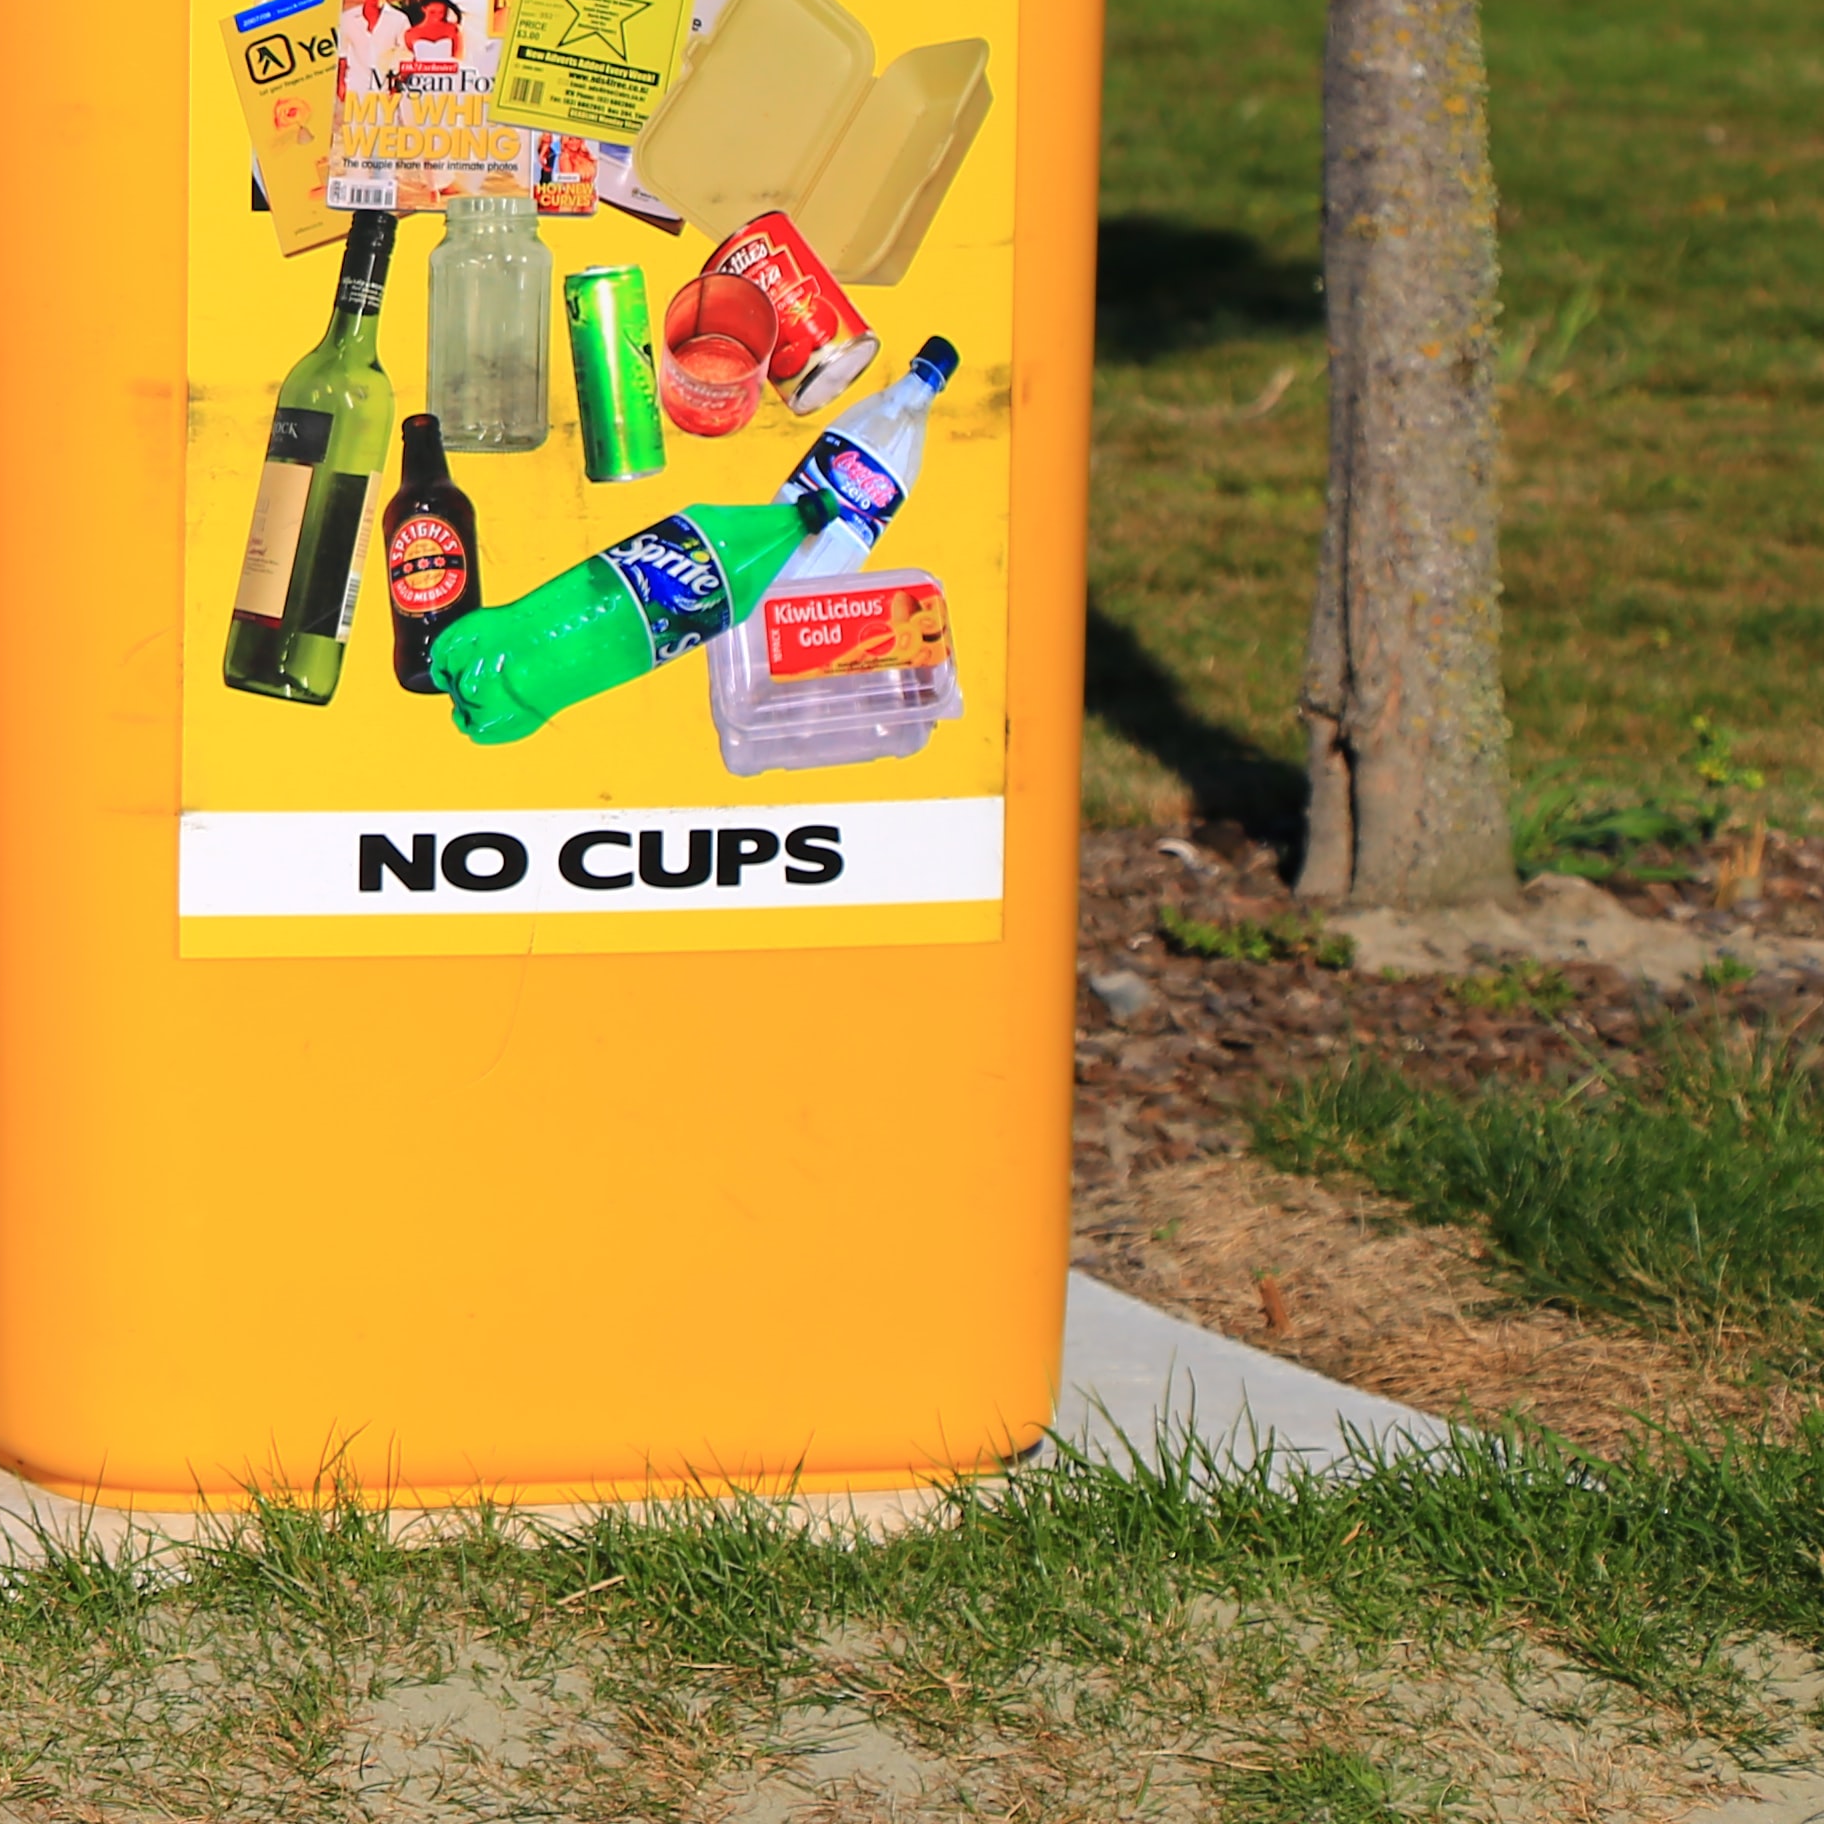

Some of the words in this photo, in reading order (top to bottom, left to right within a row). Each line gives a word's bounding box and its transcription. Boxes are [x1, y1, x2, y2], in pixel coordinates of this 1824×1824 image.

[518, 19, 548, 31] PRICE
[525, 48, 545, 60] New
[545, 51, 579, 68] Adverts
[578, 58, 606, 73] Added
[605, 63, 629, 79] Every
[343, 90, 401, 125] MY
[339, 124, 522, 162] WEDDING
[342, 157, 360, 168] The
[361, 159, 394, 172] couple
[395, 159, 421, 170] share
[423, 159, 444, 170] their
[446, 159, 486, 171] intimate
[486, 160, 519, 173] photos
[537, 182, 563, 195] HOT
[564, 182, 594, 196] NEW
[539, 194, 592, 207] CURVES
[841, 480, 871, 511] zero
[612, 532, 721, 597] Sprite
[773, 596, 884, 624] KiwiLicious
[798, 622, 843, 649] Gold
[359, 832, 529, 892] NO
[558, 824, 845, 891] CUPS
